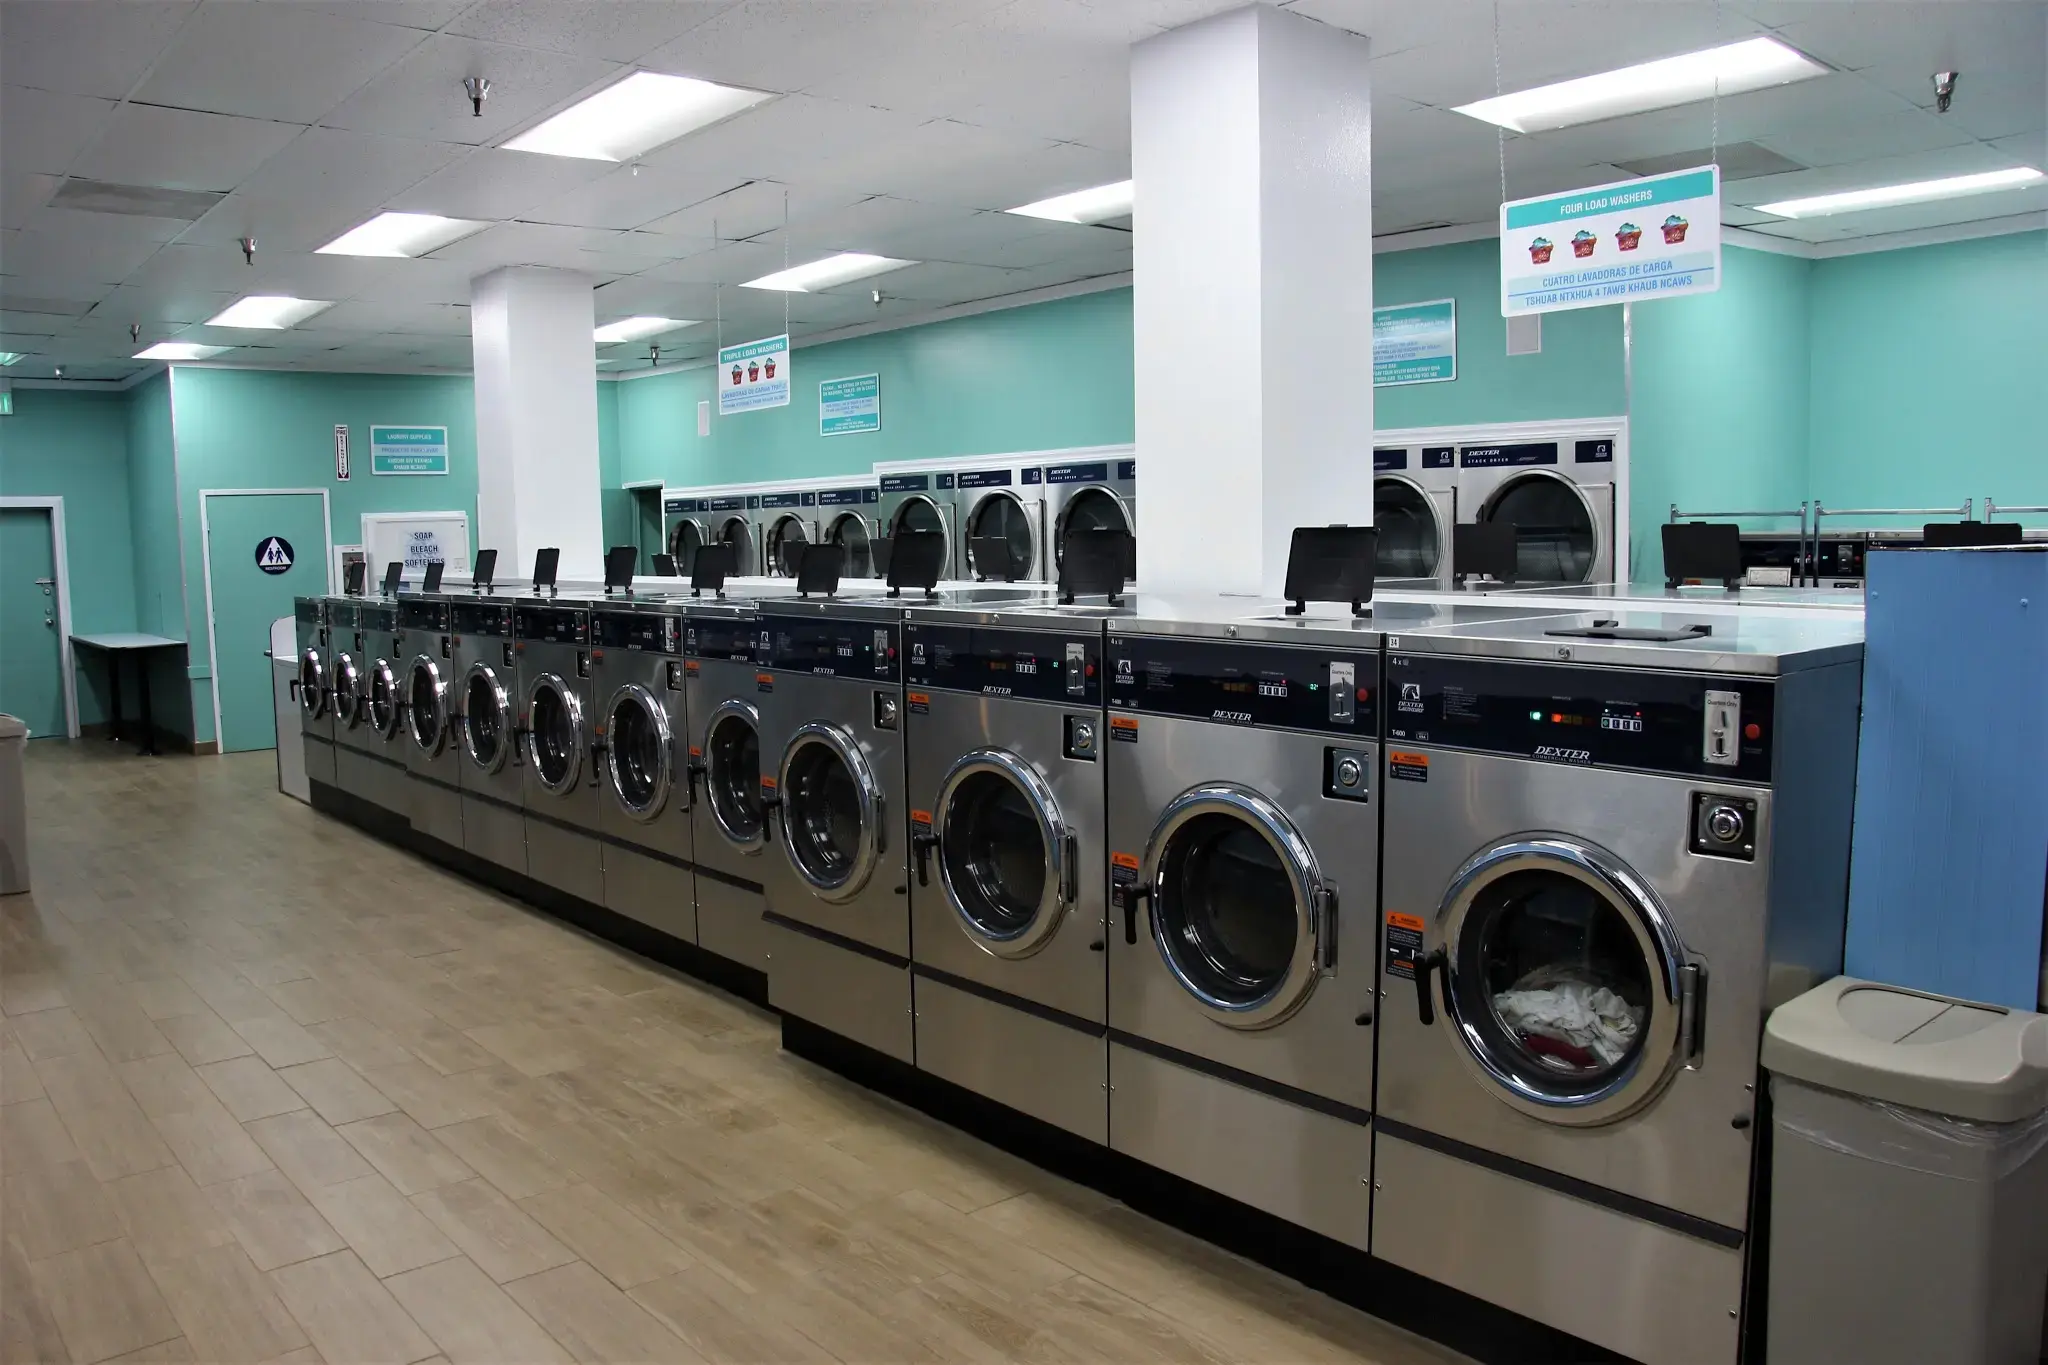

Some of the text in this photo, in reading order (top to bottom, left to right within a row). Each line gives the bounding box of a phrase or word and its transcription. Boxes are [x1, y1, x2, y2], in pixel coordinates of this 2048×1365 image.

[1560, 189, 1653, 216] FOUR LOAD WASHERS
[1542, 260, 1673, 288] CUATRO LAVADORAS DE CARGA
[1525, 275, 1692, 307] TSHUAB NTXHUA 4 TAWB KHAUB NCAWS
[724, 342, 784, 361] TRIPLE LOAD WASHERS
[1468, 449, 1500, 457] DEXTER
[414, 531, 433, 540] SOAP
[410, 545, 438, 553] BLEACH
[1390, 638, 1397, 647] 34
[1392, 657, 1397, 665] 4
[813, 666, 835, 675] DEXTER
[983, 685, 1012, 695] DEXTER
[1398, 700, 1424, 708] DEXTER
[1726, 700, 1737, 708] Only
[1212, 709, 1252, 722] DEXTER
[1533, 745, 1590, 760] DEXTER
[1532, 753, 1592, 765] COMMERCIAL WASHER
